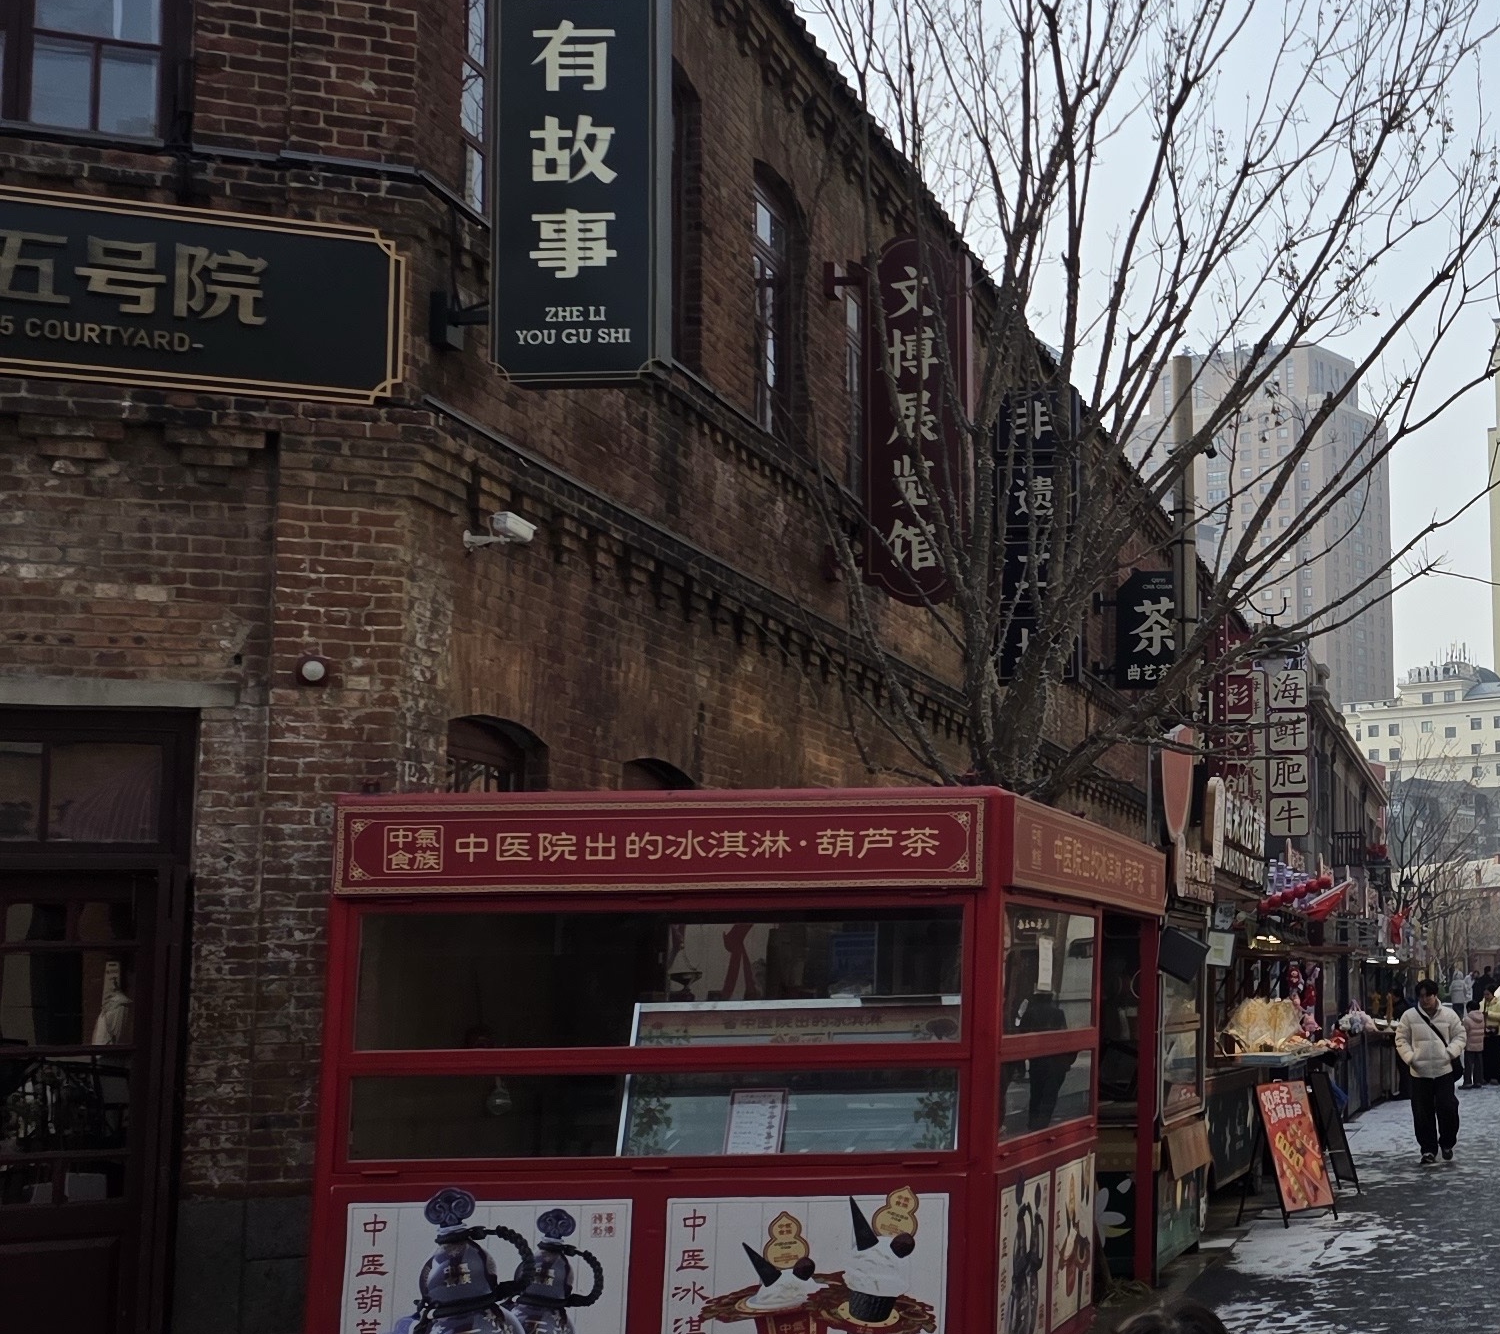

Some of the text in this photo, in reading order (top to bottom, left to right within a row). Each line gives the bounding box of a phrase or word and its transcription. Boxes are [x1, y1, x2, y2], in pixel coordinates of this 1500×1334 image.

[515, 327, 632, 345] YOU GU SHI
[545, 306, 607, 322] ZHE LI
[886, 266, 941, 572] 文博展览馆
[1128, 596, 1175, 657] 茶
[1271, 672, 1307, 834] 海鲜肥牛
